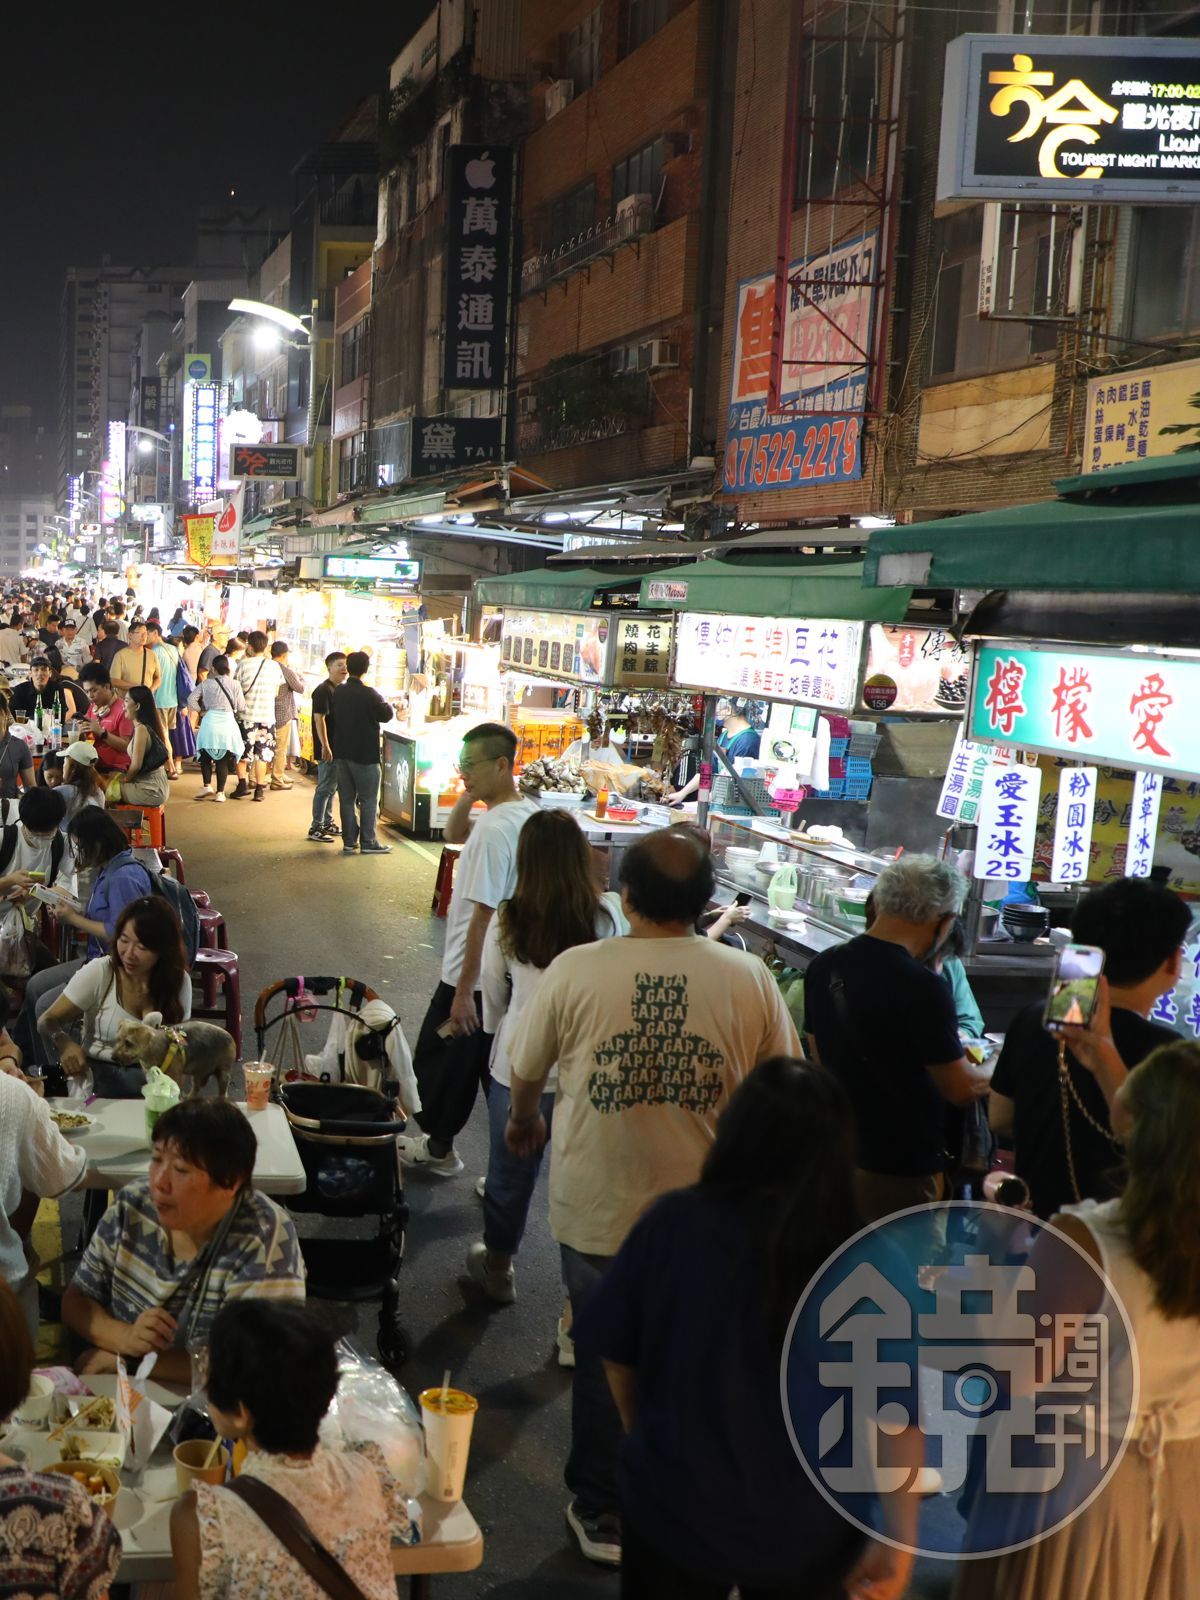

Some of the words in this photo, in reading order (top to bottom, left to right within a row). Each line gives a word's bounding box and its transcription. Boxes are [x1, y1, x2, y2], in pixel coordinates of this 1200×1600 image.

[1060, 152, 1117, 167] TOURIST
[1118, 153, 1159, 168] NIGHT
[456, 197, 499, 379] 萬泰通訊
[421, 423, 456, 458] 黛
[464, 447, 494, 457] TAI
[871, 699, 887, 709] 156
[984, 656, 1176, 758] 檸檬愛
[987, 772, 1029, 857] 愛玉冰
[1062, 772, 1091, 857] 粉圓冰
[1134, 772, 1157, 854] 仙草冰
[985, 860, 1022, 878] 25
[1060, 862, 1083, 879] 25
[1132, 859, 1149, 877] 25
[646, 988, 677, 1003] GAP
[646, 1021, 677, 1037] GAP
[629, 1037, 659, 1053] GAP
[663, 1038, 694, 1054] GAP
[645, 1052, 677, 1070] GAP
[629, 1069, 659, 1085] GAP
[661, 1070, 692, 1085] GAP
[613, 1086, 642, 1101] GAP
[646, 1084, 675, 1099] GAP
[679, 1086, 708, 1101] GAP
